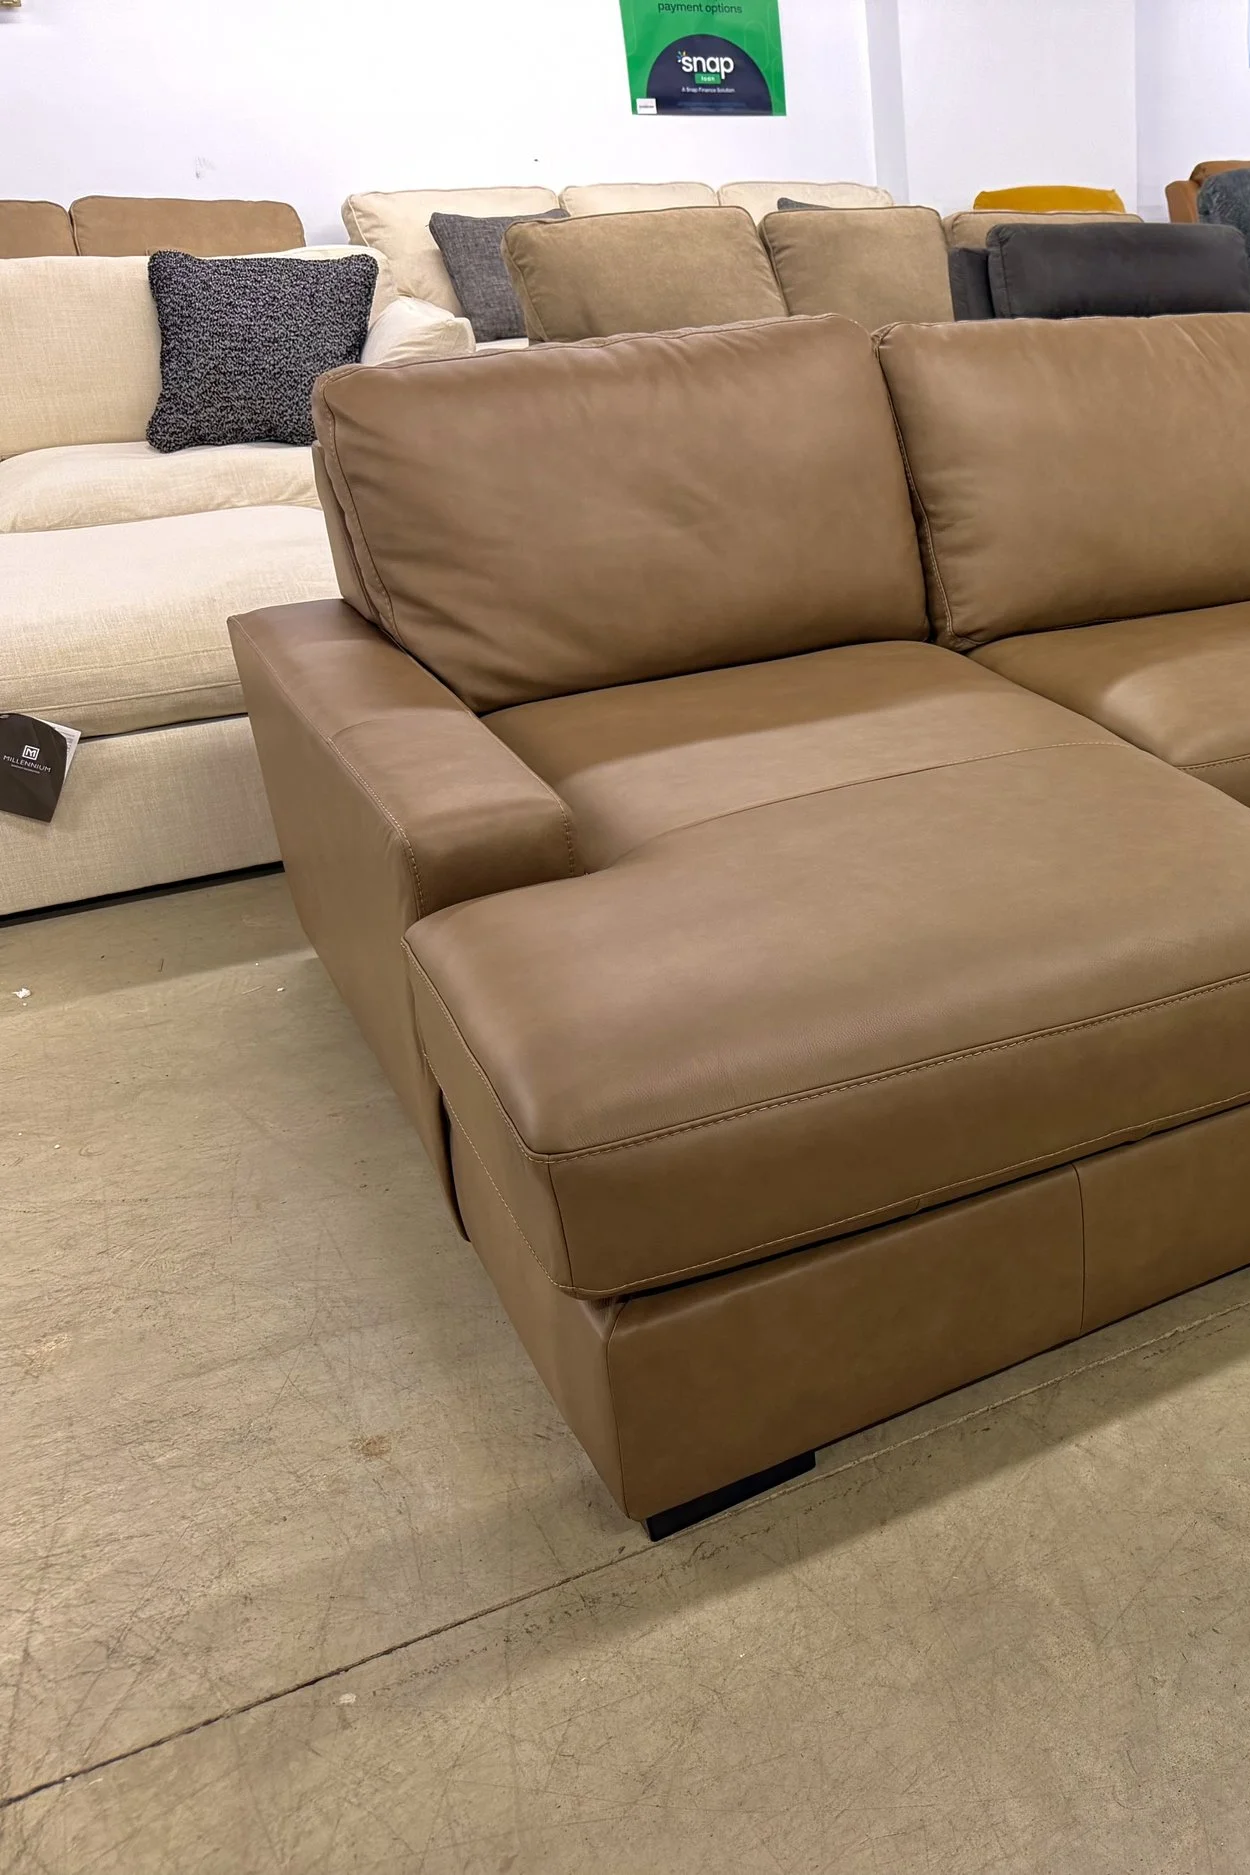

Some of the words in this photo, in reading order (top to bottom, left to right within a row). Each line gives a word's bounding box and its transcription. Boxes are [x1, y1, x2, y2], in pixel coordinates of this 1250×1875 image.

[658, 3, 703, 14] payment
[705, 4, 743, 15] options
[681, 56, 735, 80] snap
[3, 755, 52, 773] MILLENNIUM
